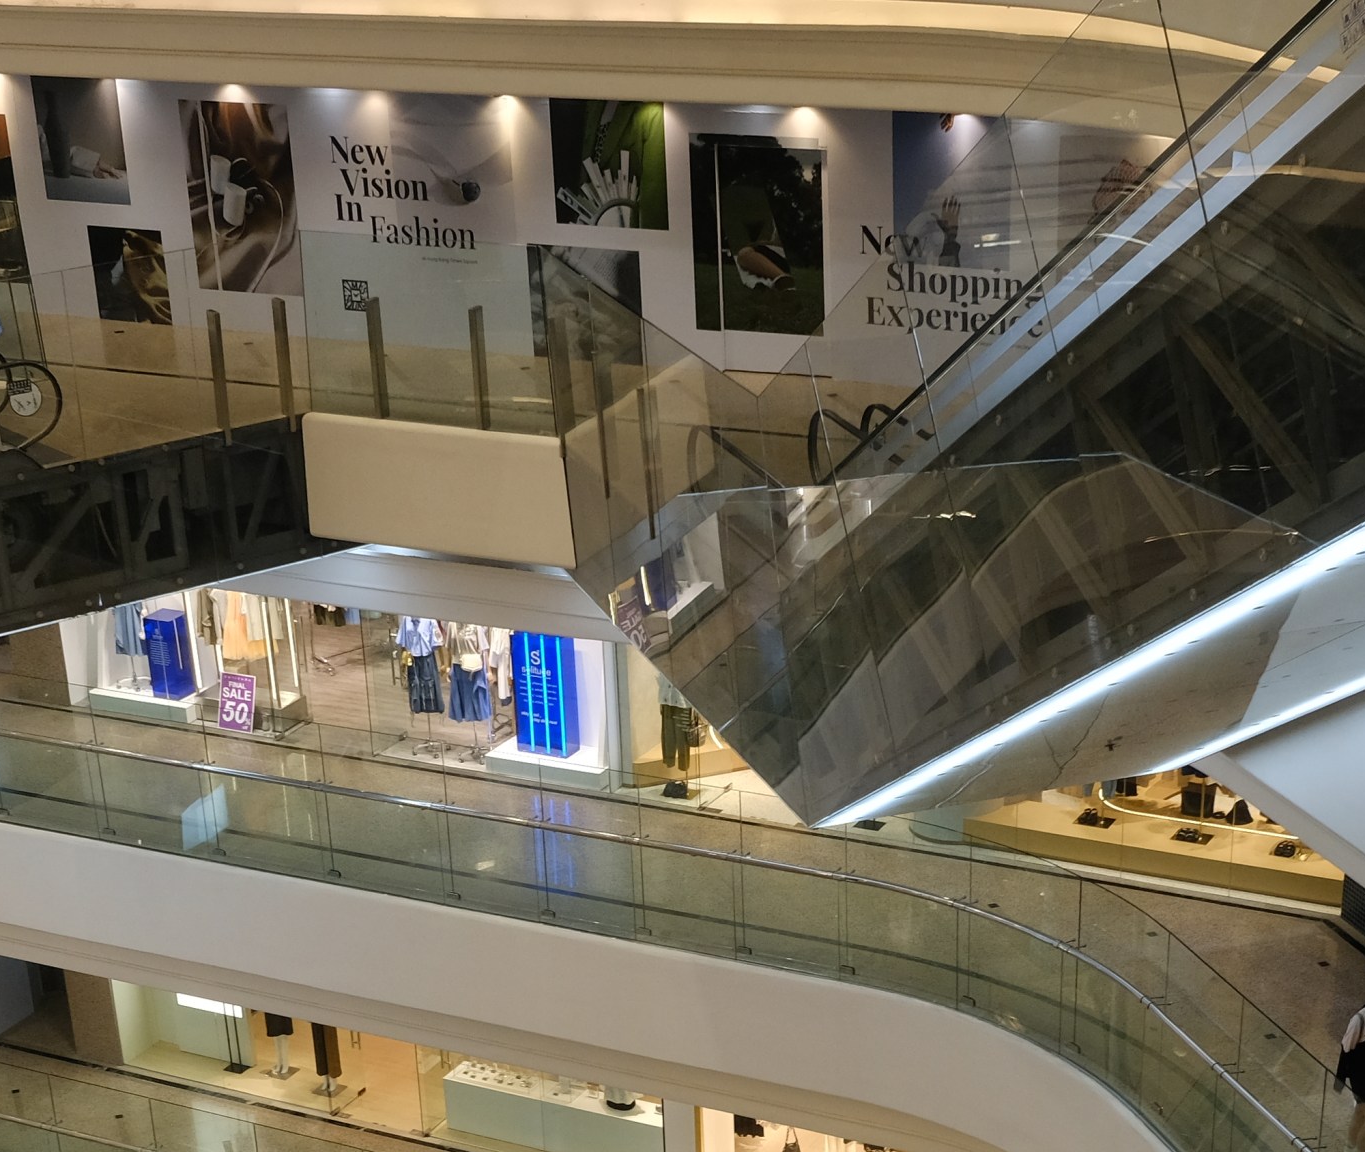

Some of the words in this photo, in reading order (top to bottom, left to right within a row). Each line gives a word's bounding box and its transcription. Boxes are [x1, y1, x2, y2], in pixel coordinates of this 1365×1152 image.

[329, 135, 388, 166] New
[339, 167, 429, 201] Vision
[334, 193, 364, 222] In
[370, 215, 476, 250] Fashion
[860, 224, 927, 258] New
[222, 686, 252, 702] SALE
